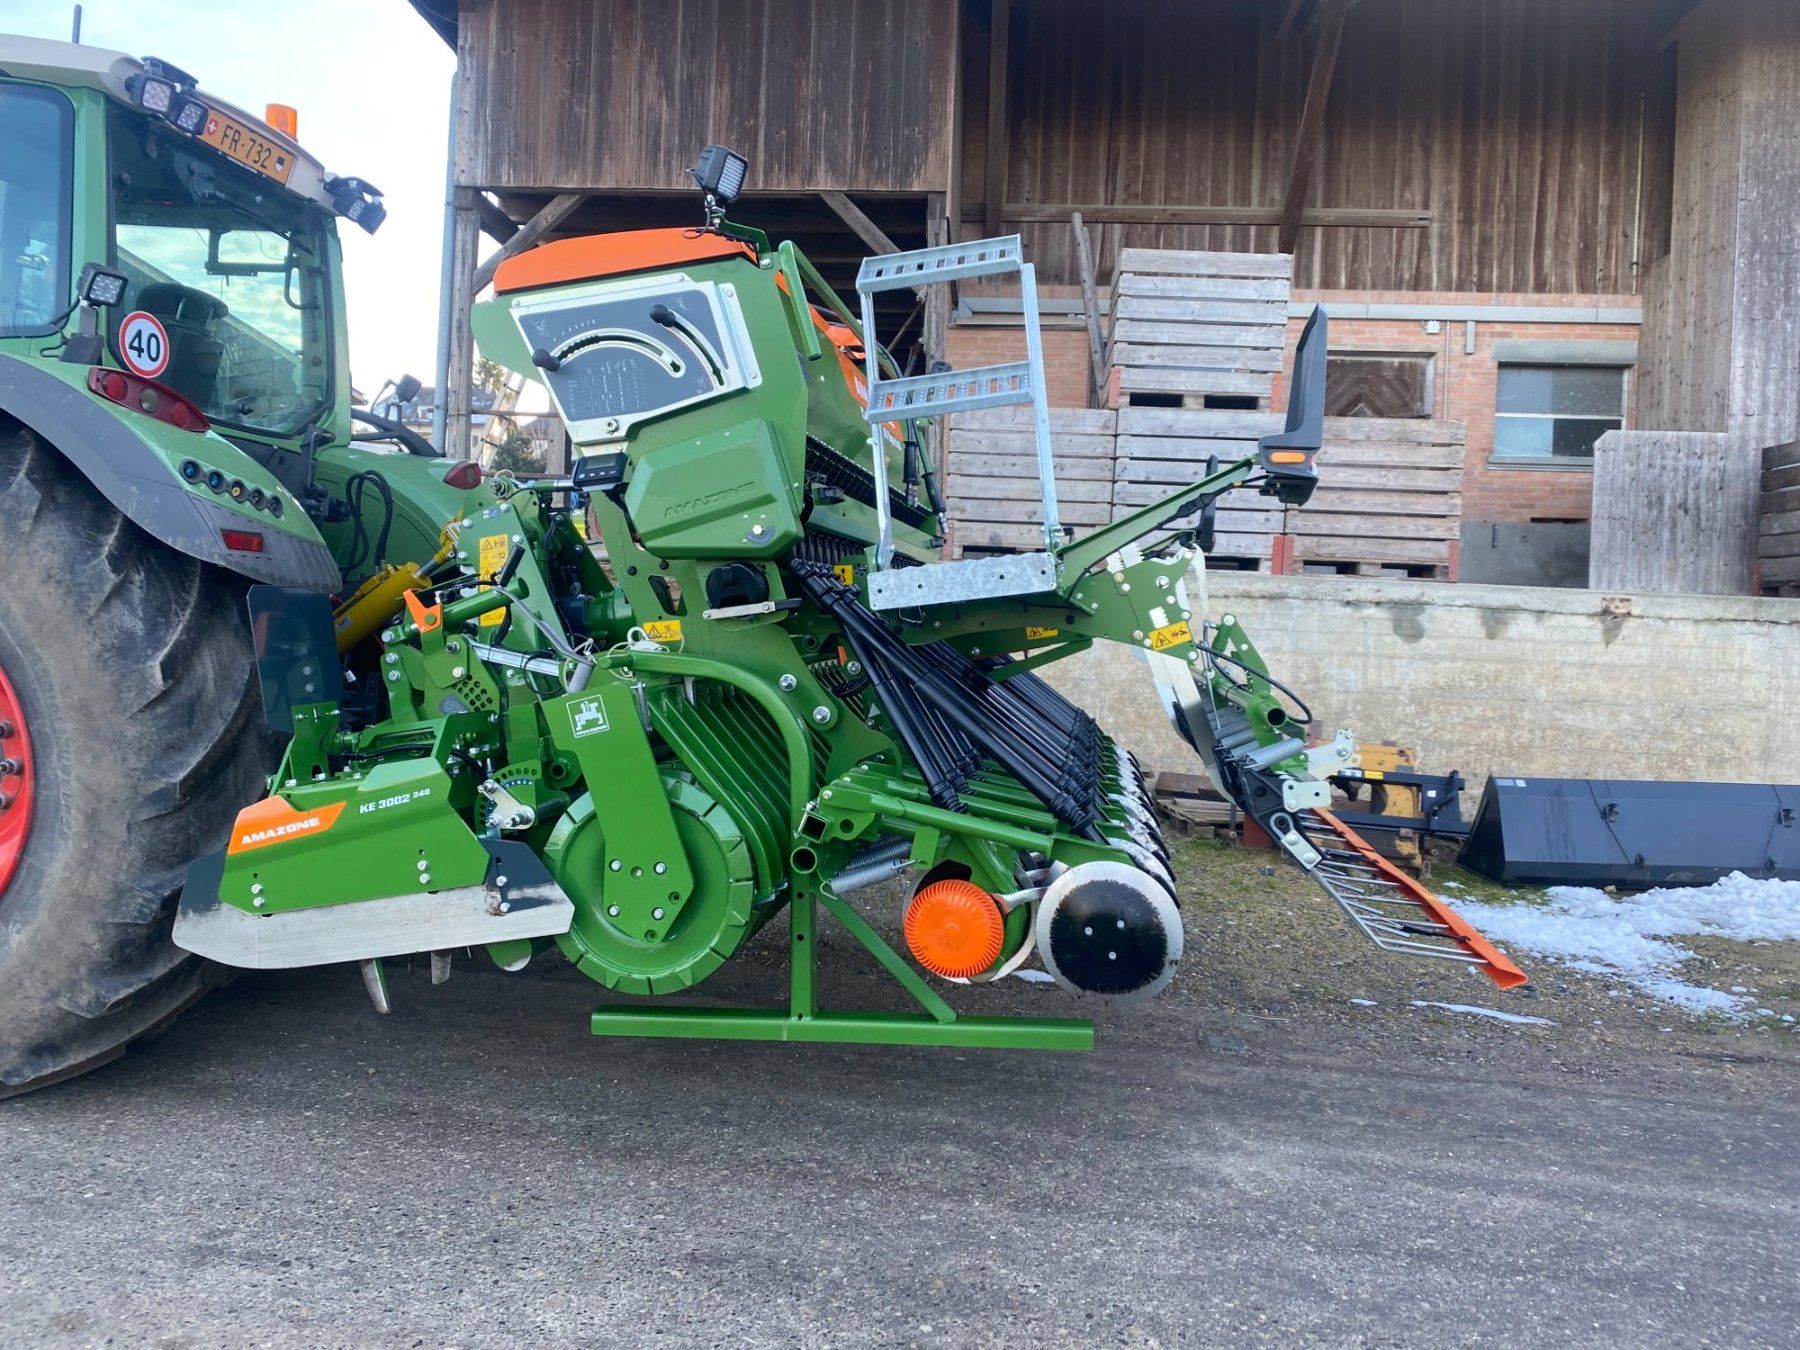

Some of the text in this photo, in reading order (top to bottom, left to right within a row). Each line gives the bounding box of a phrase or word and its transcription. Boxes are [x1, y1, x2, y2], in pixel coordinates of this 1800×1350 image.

[128, 328, 160, 362] 40
[359, 788, 431, 814] KE 3002 240
[241, 817, 320, 845] AMAZONE
